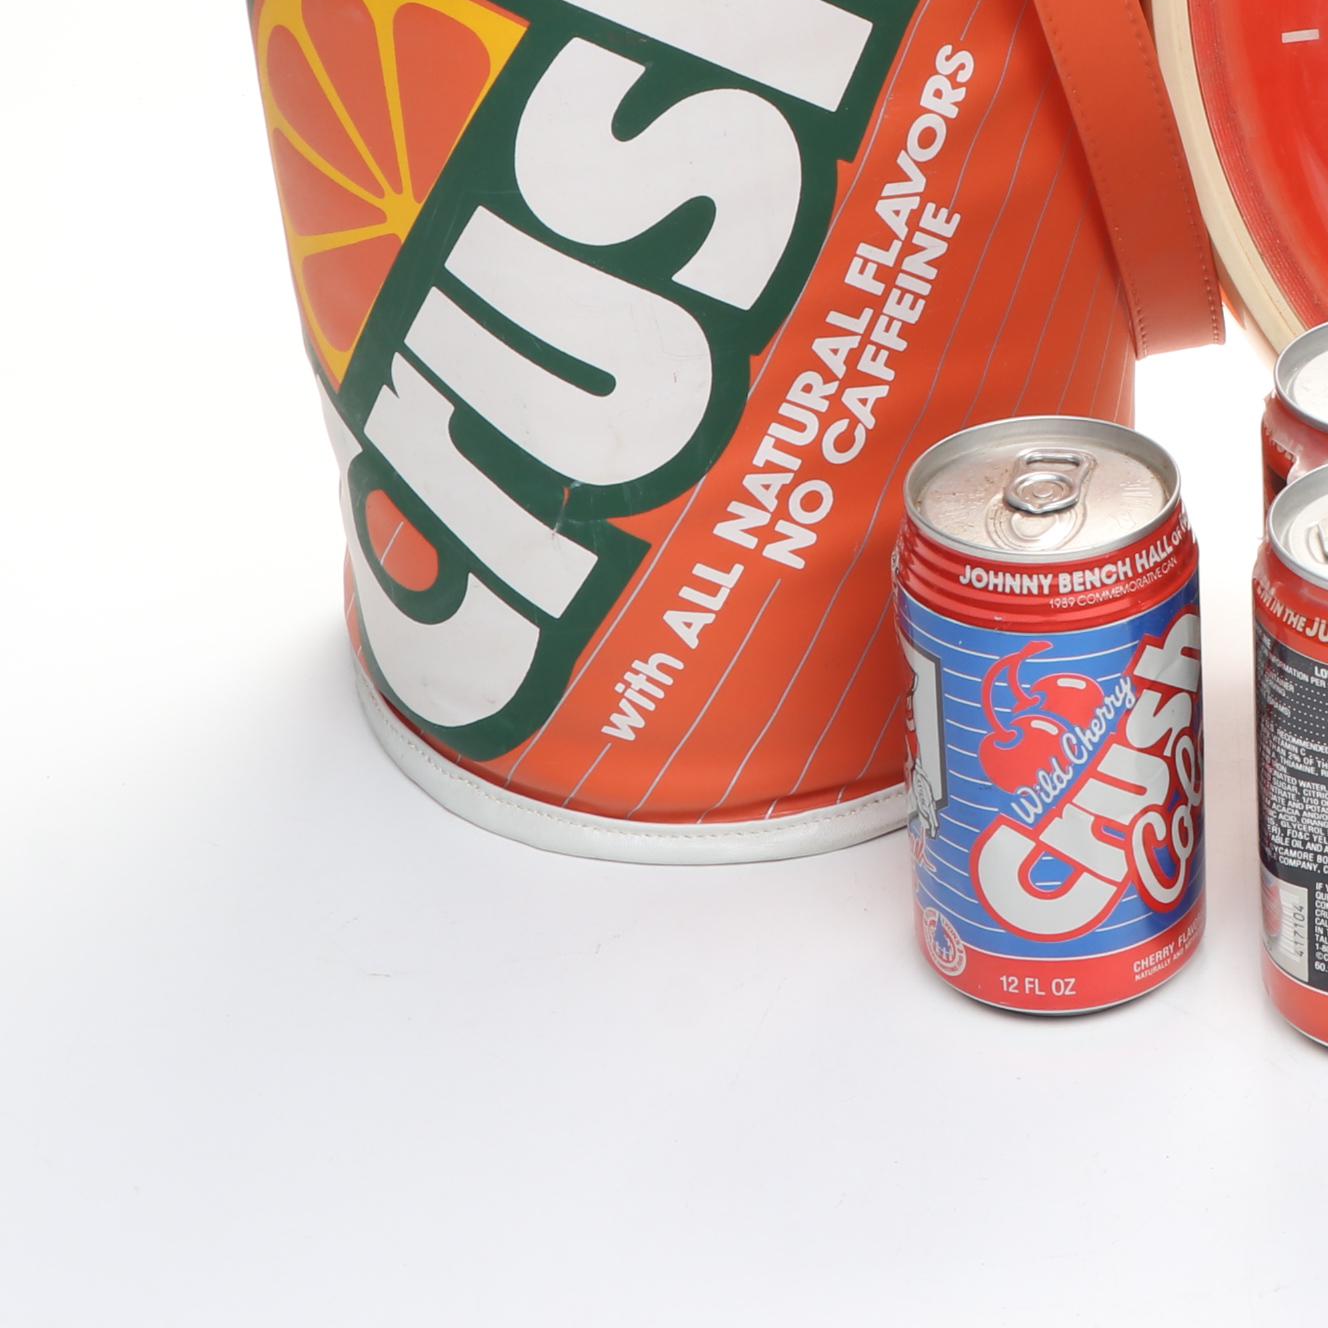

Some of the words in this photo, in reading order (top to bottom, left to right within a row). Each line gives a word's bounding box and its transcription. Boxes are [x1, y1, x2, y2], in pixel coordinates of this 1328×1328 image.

[601, 649, 684, 743] with
[661, 560, 745, 649] ALL
[712, 308, 876, 550] NATURAL
[844, 43, 974, 296] FLAVORS
[761, 478, 834, 570] NO
[821, 201, 961, 465] CAFFEINE
[960, 564, 1053, 595] JOHNNY
[1058, 558, 1131, 593] BENCH
[1135, 536, 1173, 573] HALL
[1172, 528, 1182, 545] OF
[1049, 596, 1075, 608] 1989
[1077, 570, 1161, 606] COMMEMORATIVE
[1161, 557, 1177, 574] CAN
[1271, 599, 1283, 617] IN
[1283, 608, 1306, 632] THE
[1012, 757, 1073, 824] Wild
[1063, 677, 1135, 764] Cherry
[979, 613, 1201, 935] Crush
[1280, 821, 1324, 836] GLYCEROL
[1279, 857, 1320, 873] COMPANY,
[1316, 882, 1323, 890] IF
[1293, 905, 1305, 956] 417104
[1315, 926, 1323, 934] IN
[1315, 935, 1328, 944] TAL
[1133, 942, 1175, 972] CHERRY
[1135, 958, 1171, 981] NATURALLY
[1001, 975, 1020, 994] 12
[1024, 976, 1046, 996] FL
[1051, 976, 1077, 997] OZ
